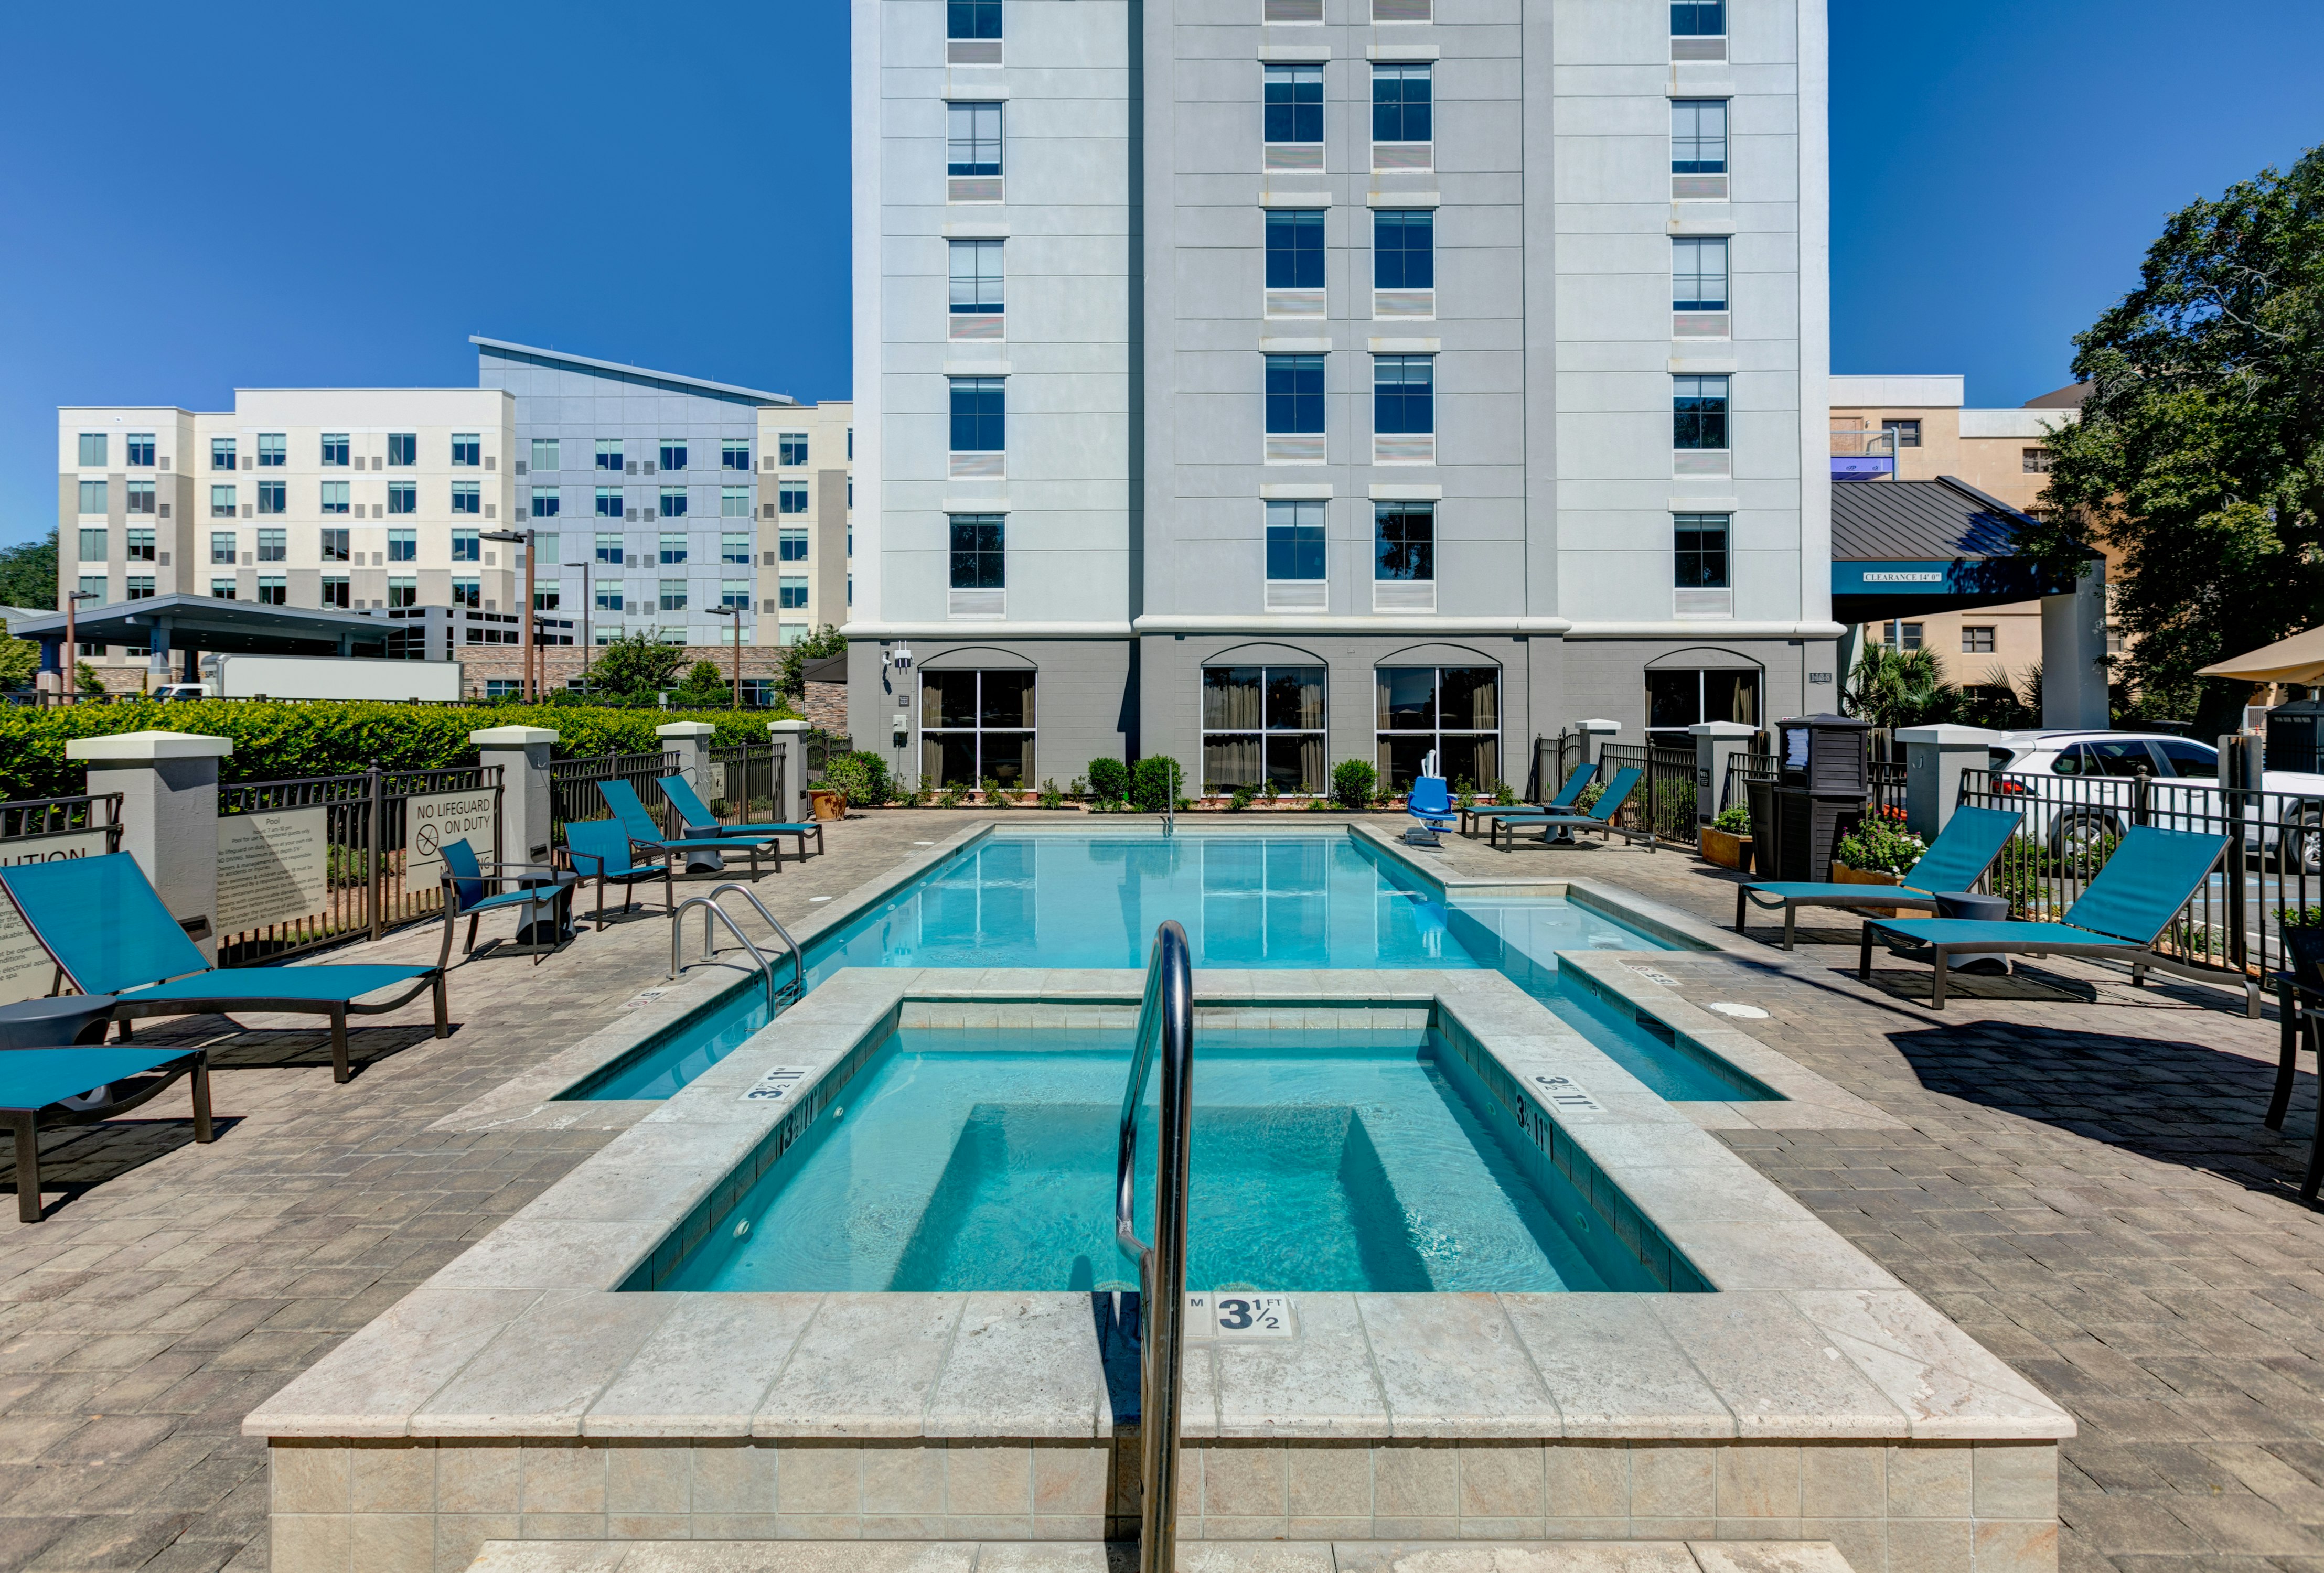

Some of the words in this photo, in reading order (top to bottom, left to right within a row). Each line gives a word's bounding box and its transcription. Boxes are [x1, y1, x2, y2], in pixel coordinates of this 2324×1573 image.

[417, 805, 434, 819] NO
[438, 799, 490, 817] LIFEGUARD
[445, 820, 460, 834] ON
[464, 815, 490, 831] DUTY
[217, 882, 248, 892] accompanied
[248, 892, 280, 902] communicable
[3, 962, 31, 973] electrical
